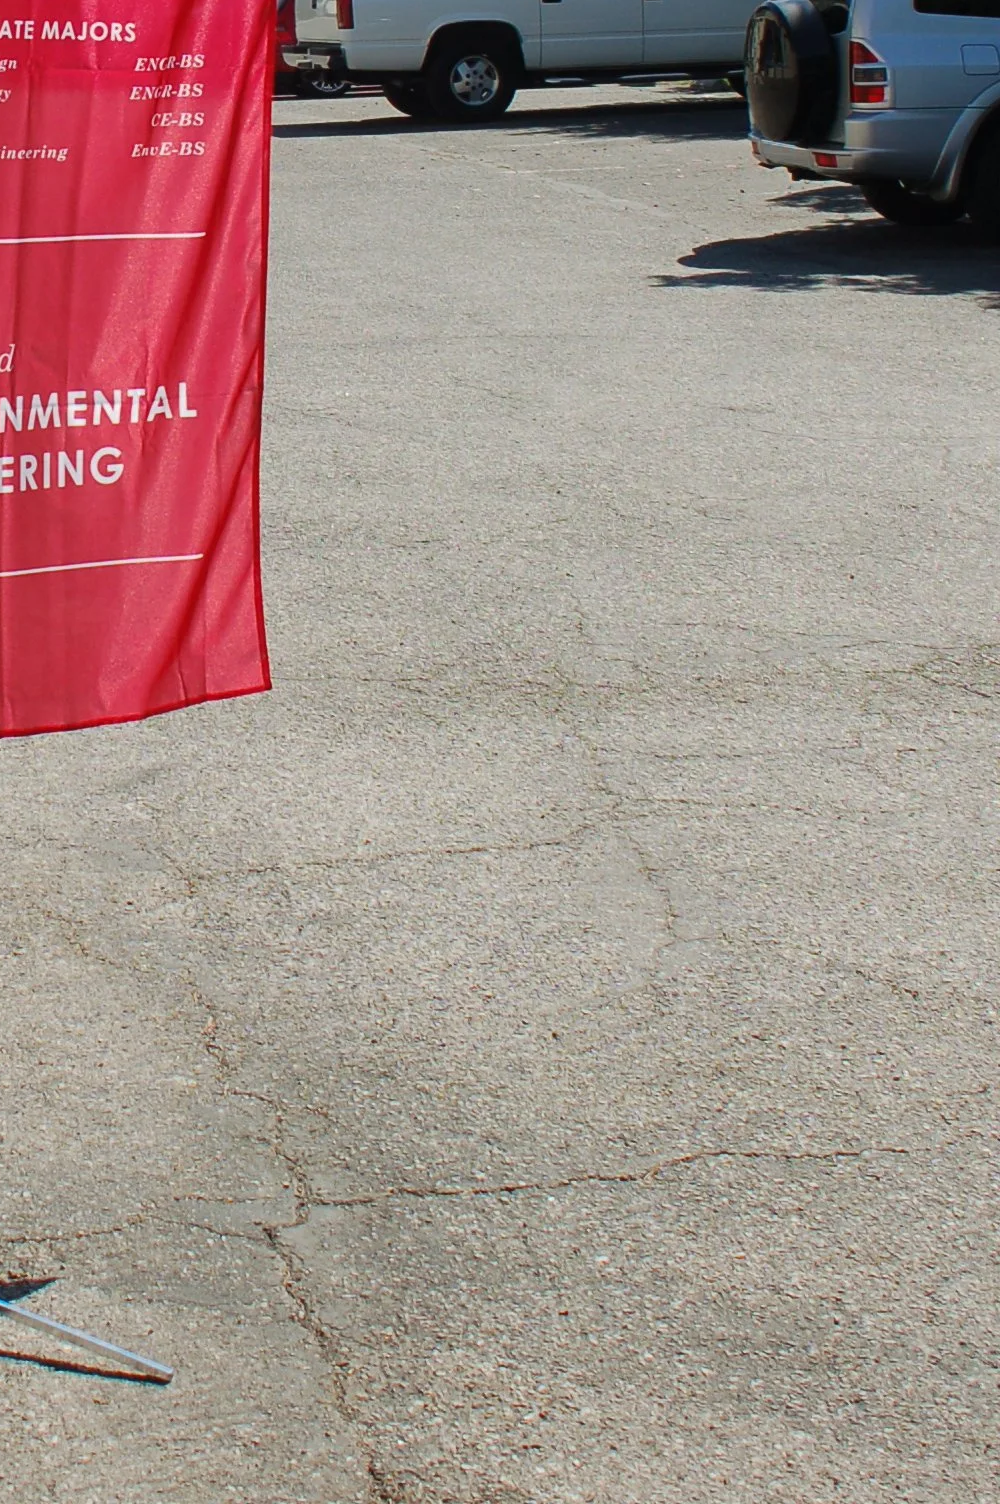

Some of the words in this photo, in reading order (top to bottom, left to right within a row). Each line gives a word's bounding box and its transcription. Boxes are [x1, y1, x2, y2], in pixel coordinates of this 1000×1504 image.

[41, 20, 136, 43] MAJORS
[151, 112, 205, 127] CE-BS
[131, 141, 206, 158] EnvE-BS
